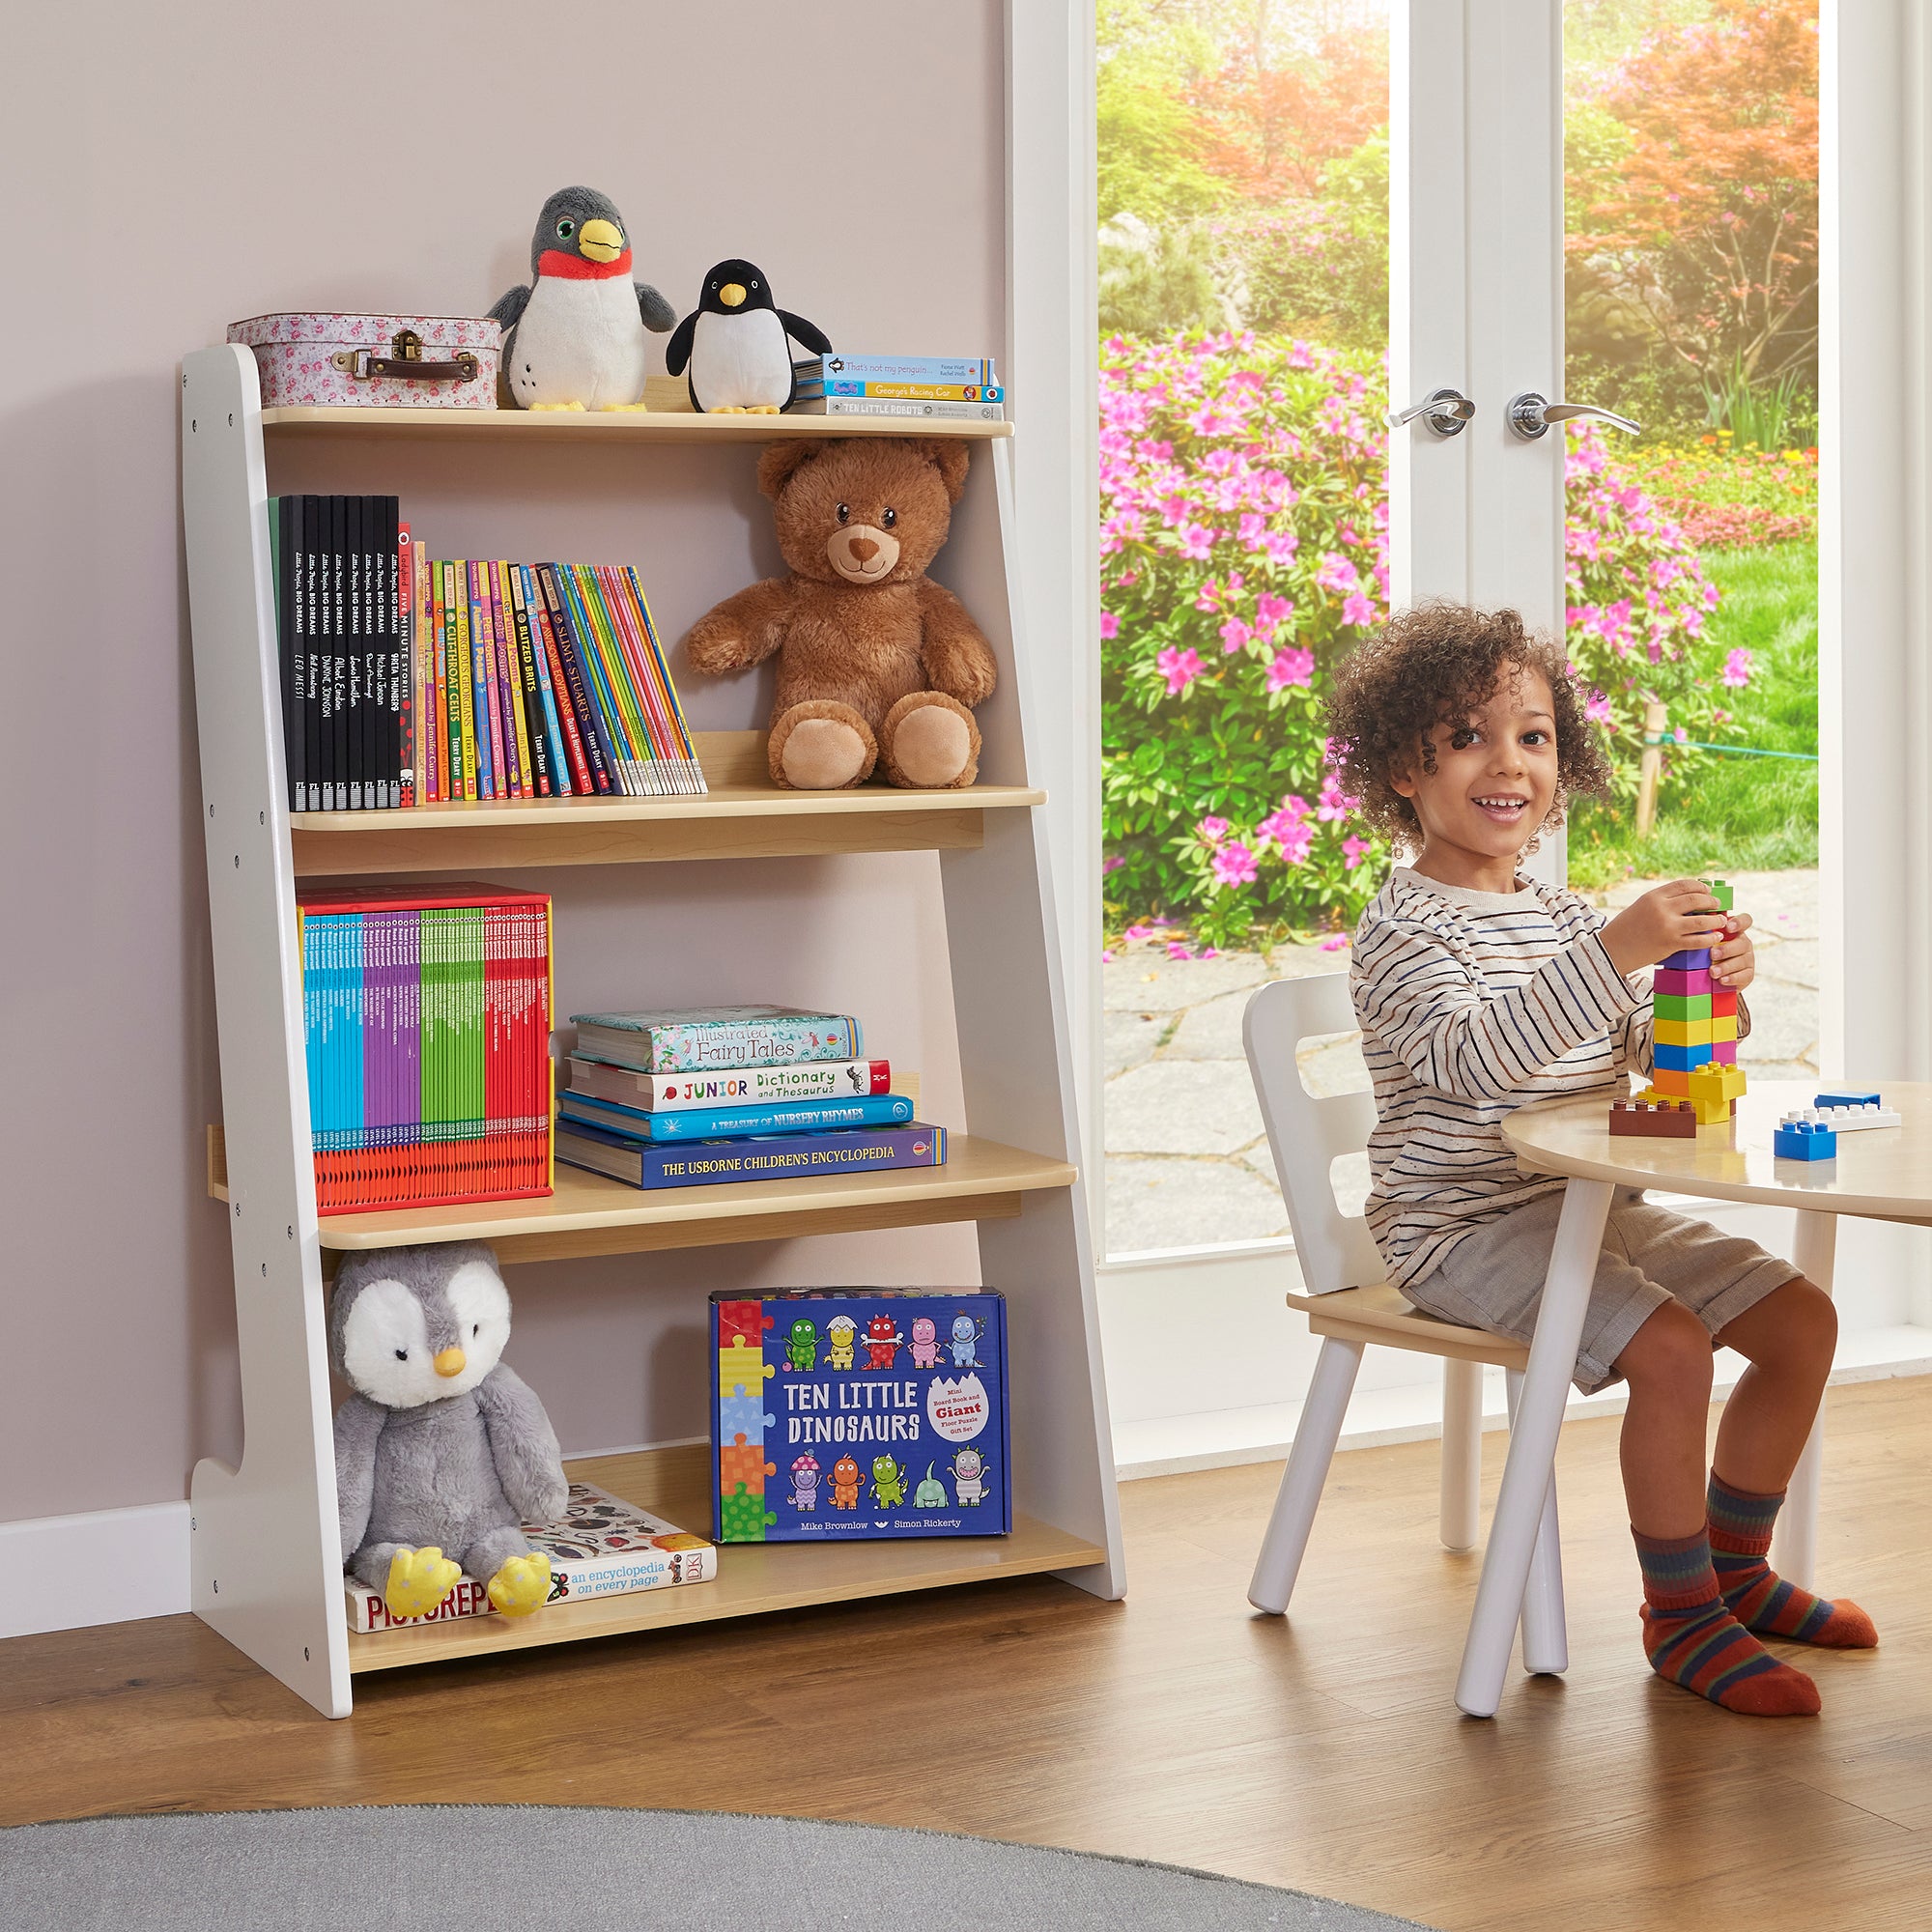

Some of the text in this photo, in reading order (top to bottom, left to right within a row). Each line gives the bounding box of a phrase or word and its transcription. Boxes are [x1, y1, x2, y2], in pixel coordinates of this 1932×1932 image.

[884, 366, 896, 376] my
[875, 384, 952, 399] George's Racing Car
[843, 403, 923, 415] TEN LITTLE ROBOTS
[400, 554, 409, 586] Ladybird
[483, 616, 493, 635] Pet
[494, 605, 508, 679] Magic Poems
[505, 613, 518, 684] Funny Poems
[295, 655, 303, 669] LEO
[484, 639, 495, 675] Poems
[519, 625, 536, 693] BLITZED BRITS
[335, 658, 345, 680] Albert
[446, 626, 460, 723] CUT-THROAT CELTS
[460, 623, 471, 727] GORGEOUS GEORGIANS
[542, 626, 560, 668] AWESOME
[554, 668, 573, 716] EGYPTIANS
[557, 626, 591, 722] SLIMY STUARTS
[323, 686, 331, 717] JOHNSON
[490, 716, 499, 744] Jennifer
[566, 716, 576, 733] DEARY
[427, 722, 436, 755] Jennifer
[452, 736, 461, 755] TERRY
[587, 730, 602, 769] TERRY DEARY
[537, 753, 546, 774] DEARY
[696, 1025, 769, 1041] Illustrated
[696, 1039, 795, 1064] Fairy Tales
[684, 1080, 748, 1099] JUNIOR
[756, 1070, 836, 1087] Dictionary
[758, 1085, 835, 1097] and Thesaurus
[711, 1107, 865, 1131] A TREASURY OF NURSERY RHYMES
[662, 1146, 895, 1177] THE USBORNE CHILDREN'S ENCYCLOPEDIA
[783, 1381, 918, 1411] TEN LITTLE
[935, 1403, 981, 1419] Giant
[958, 1416, 978, 1425] Puzzle
[787, 1413, 921, 1444] DINOSAURS
[825, 1520, 868, 1530] Brownlow
[895, 1517, 961, 1528] Simon Rickerty
[571, 1561, 665, 1584] an encyclopedia
[687, 1553, 701, 1580] DK
[578, 1575, 659, 1595] on every page
